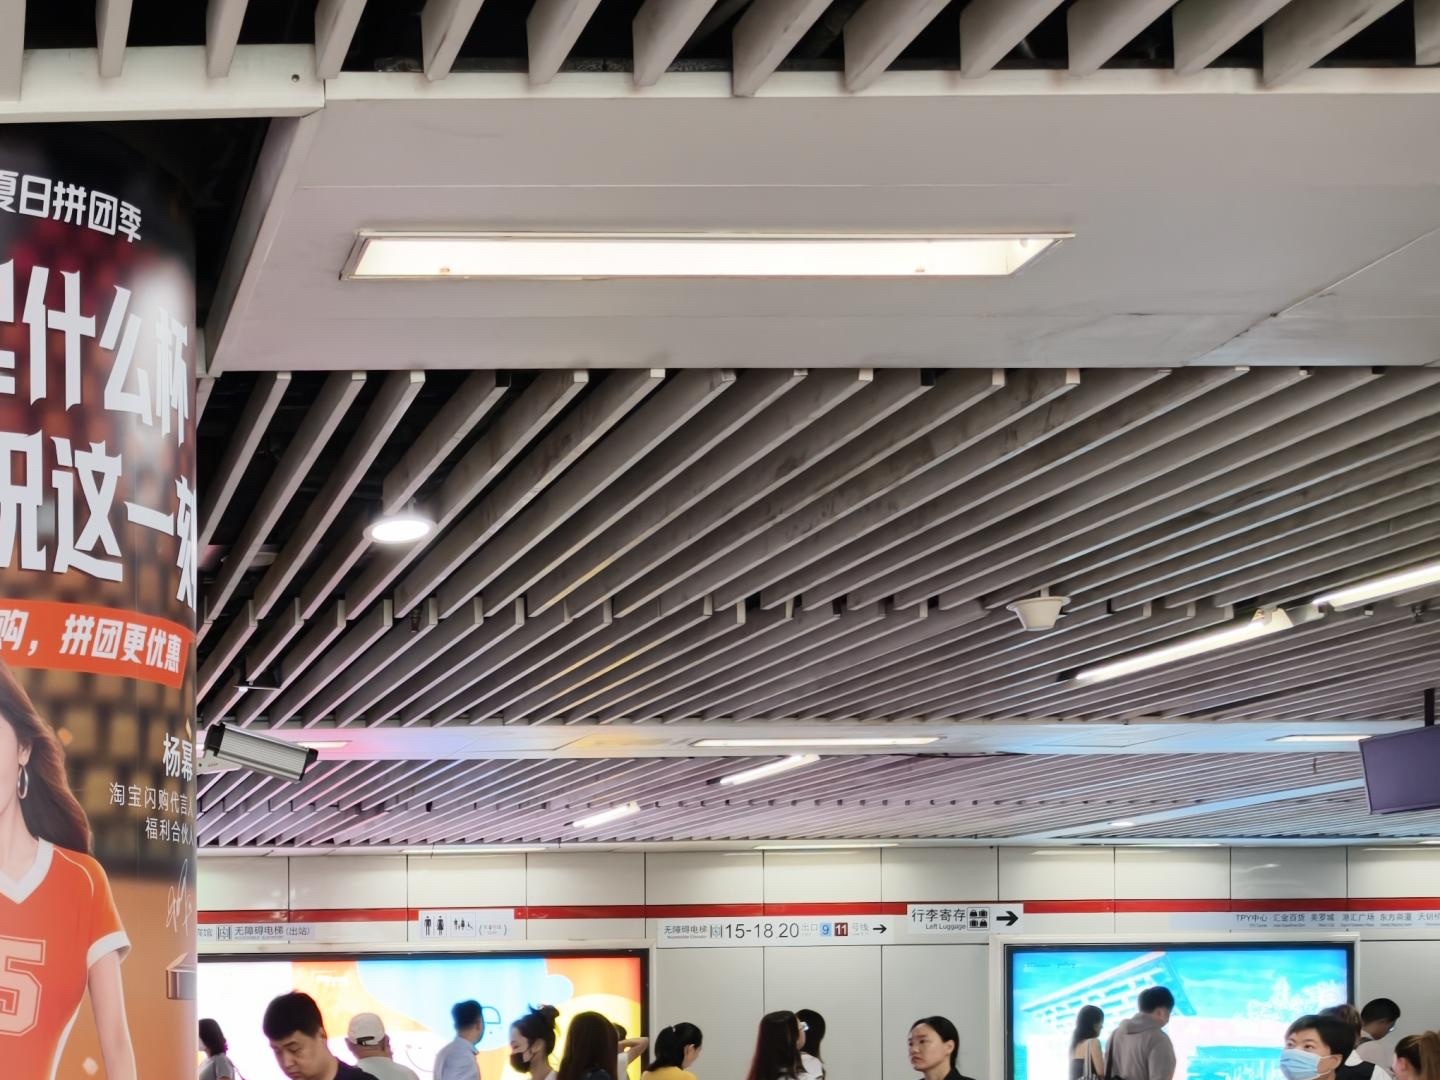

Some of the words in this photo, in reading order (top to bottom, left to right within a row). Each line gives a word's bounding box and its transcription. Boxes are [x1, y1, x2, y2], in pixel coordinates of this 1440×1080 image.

[162, 732, 193, 782] 杨幂
[145, 817, 194, 846] 福利合伙人
[912, 908, 966, 922] 行李寄存
[725, 923, 774, 939] 15-18
[778, 923, 800, 938] 20
[822, 924, 830, 935] 9
[835, 923, 848, 936] 11
